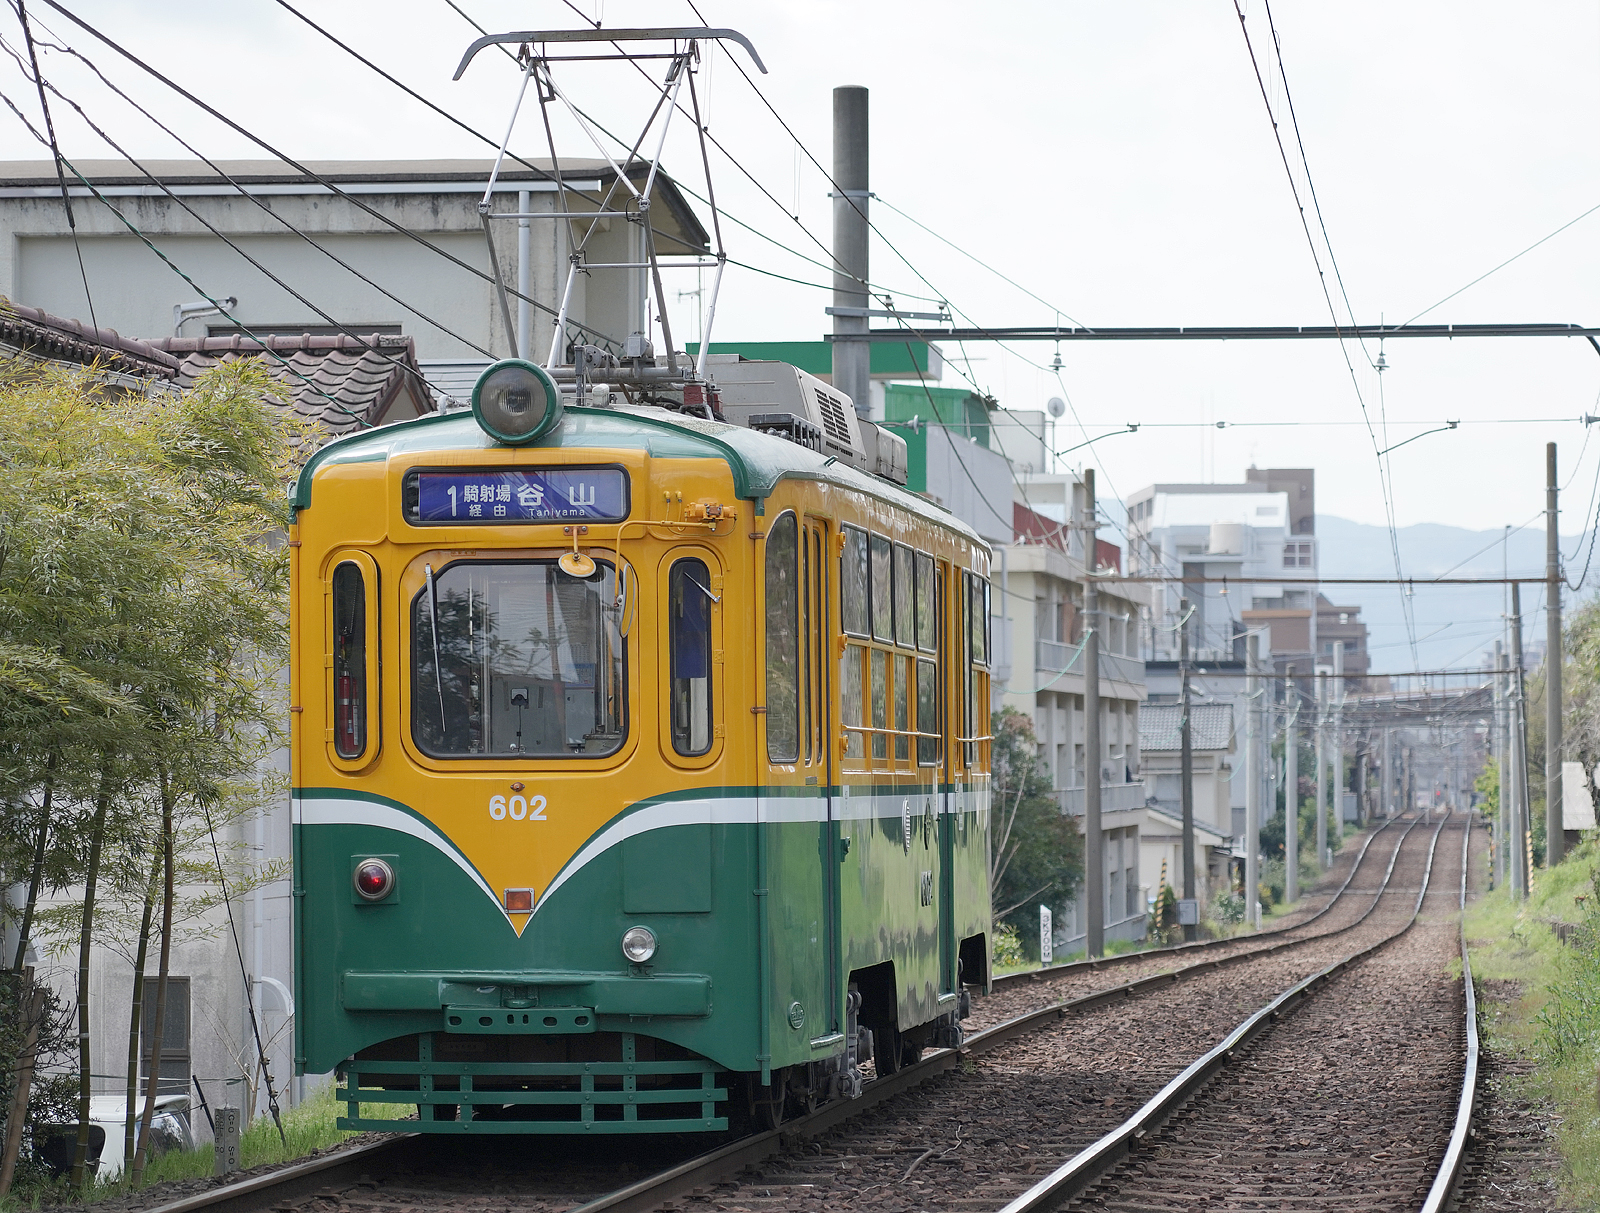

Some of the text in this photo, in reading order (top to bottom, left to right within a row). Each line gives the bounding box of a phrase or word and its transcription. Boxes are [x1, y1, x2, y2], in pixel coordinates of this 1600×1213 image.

[447, 485, 457, 517] 1
[464, 484, 511, 503] 騎射場
[469, 503, 507, 517] 経由
[528, 508, 585, 518] Taniyama
[489, 794, 547, 821] 602
